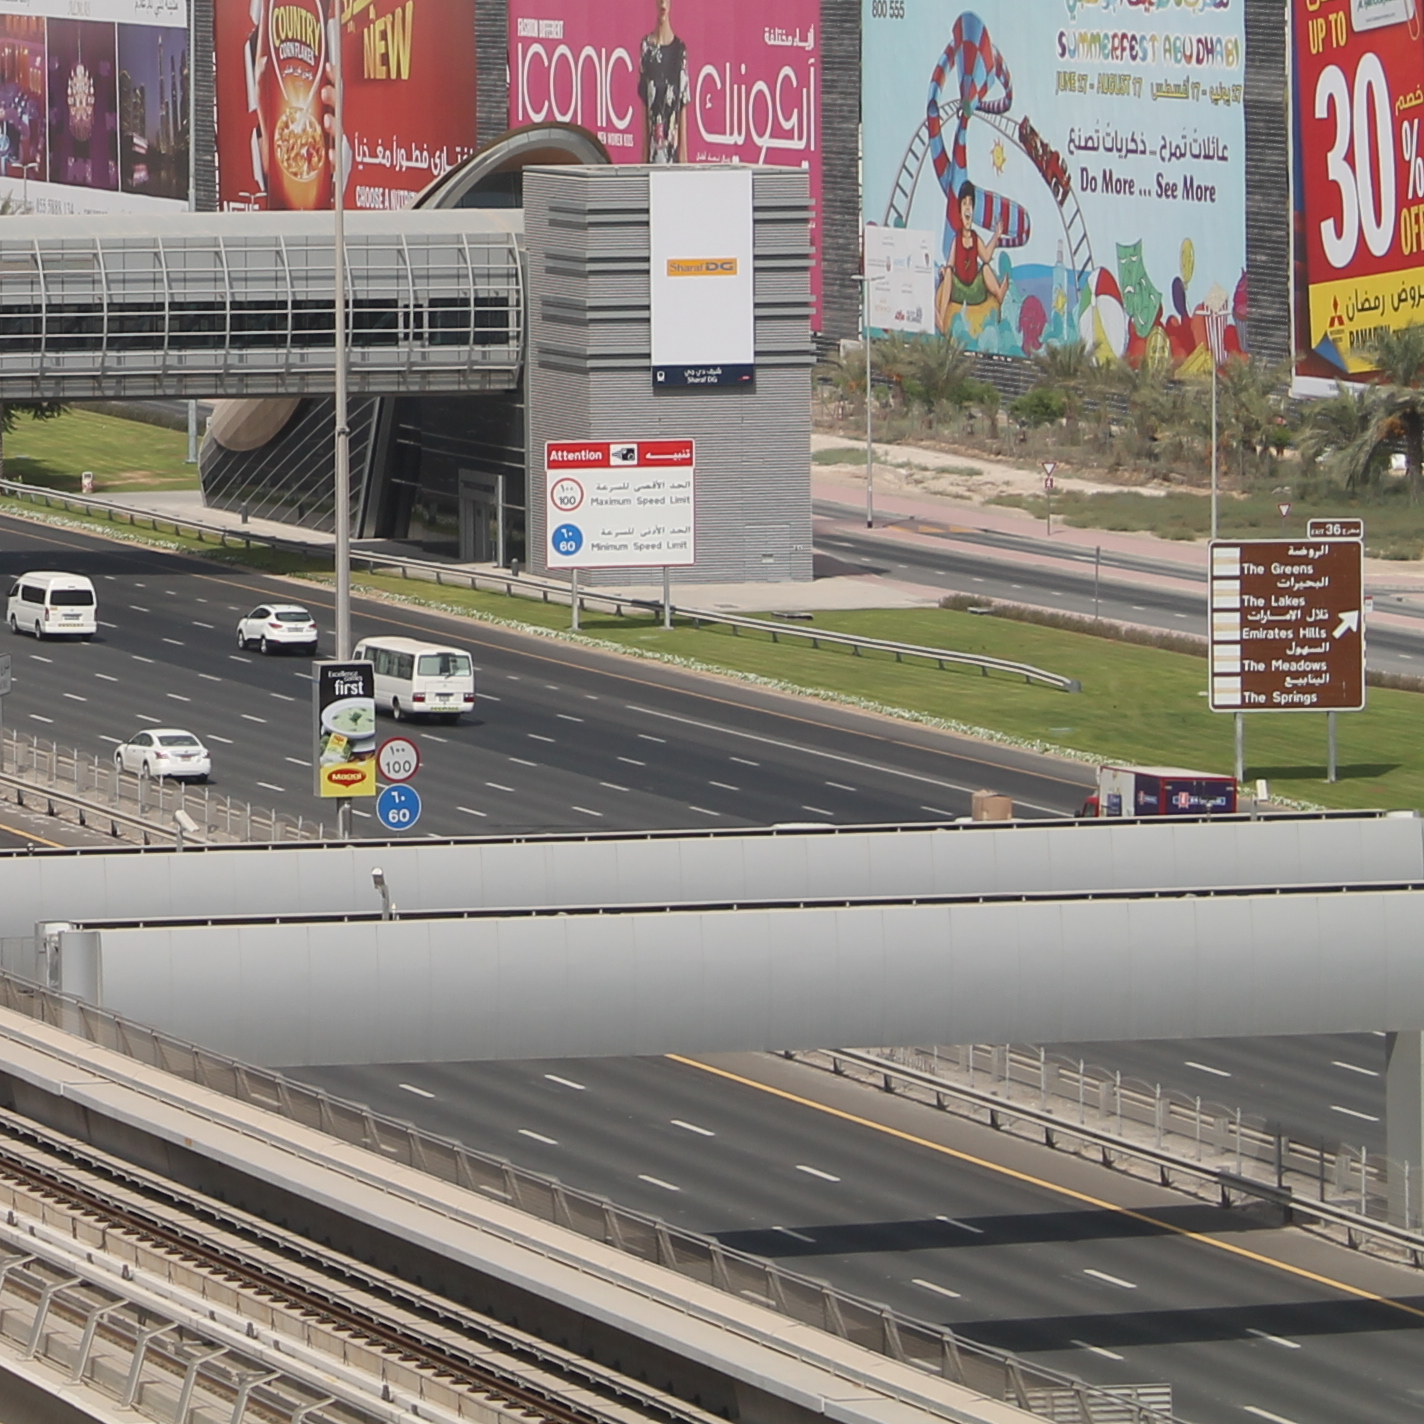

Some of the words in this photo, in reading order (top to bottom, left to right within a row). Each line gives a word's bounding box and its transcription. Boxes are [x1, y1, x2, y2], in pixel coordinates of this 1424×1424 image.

[889, 0, 905, 19] 555
[273, 5, 321, 56] COUNTRY
[764, 26, 793, 46] مختلفة
[1308, 17, 1326, 55] UP
[1328, 12, 1347, 50] TO
[364, 0, 414, 80] NEW
[279, 41, 295, 59] CORN
[295, 42, 315, 66] FLAKES
[1057, 30, 1159, 63] SUMMERFEST
[1163, 34, 1193, 65] ABU
[1195, 36, 1240, 68] DHABI
[518, 43, 633, 130] ICONIC
[1056, 70, 1076, 96] JUNE
[1077, 72, 1088, 94] 27
[1097, 72, 1131, 97] AUGUST
[1132, 74, 1143, 99] 17
[1313, 51, 1398, 269] 30
[1080, 166, 1098, 193] Do
[1102, 167, 1135, 196] More
[1155, 172, 1178, 199] See
[1182, 174, 1216, 203] More
[356, 185, 383, 208] CHOOSE
[670, 262, 703, 273] Sharaf
[705, 261, 734, 272] DG
[1345, 289, 1385, 322] رمضان
[550, 450, 602, 462] Attention
[595, 482, 629, 493] للسرعة
[634, 479, 665, 492] الأقصى
[669, 481, 690, 490] الحد
[559, 495, 576, 506] 100
[591, 497, 631, 506] Maximum
[636, 496, 665, 507] Speed
[670, 495, 691, 505] Limit
[669, 526, 690, 535] الحد
[1325, 524, 1341, 536] 36
[559, 541, 576, 552] 60
[591, 542, 628, 551] Minimum
[633, 541, 662, 552] Speed
[667, 541, 687, 550] Limit
[1287, 544, 1328, 559] الروضة
[1242, 562, 1264, 574] The
[1271, 562, 1313, 574] Greens
[1276, 576, 1328, 591] البحيرات
[1242, 594, 1265, 606] The
[1271, 594, 1305, 606] Lakes
[1306, 608, 1328, 622] تلال
[1242, 627, 1293, 639] Emirates
[1299, 626, 1327, 639] Hills
[1286, 642, 1330, 656] السهول
[1243, 659, 1265, 671] The
[1271, 659, 1327, 671] Meadows
[334, 679, 364, 695] first
[1284, 673, 1330, 687] الينابيع
[1243, 691, 1266, 704] The
[1272, 691, 1317, 707] Springs
[389, 745, 406, 756] ١٠٠
[385, 760, 412, 774] 100
[391, 791, 406, 804] ٦٠
[388, 808, 410, 823] 60
